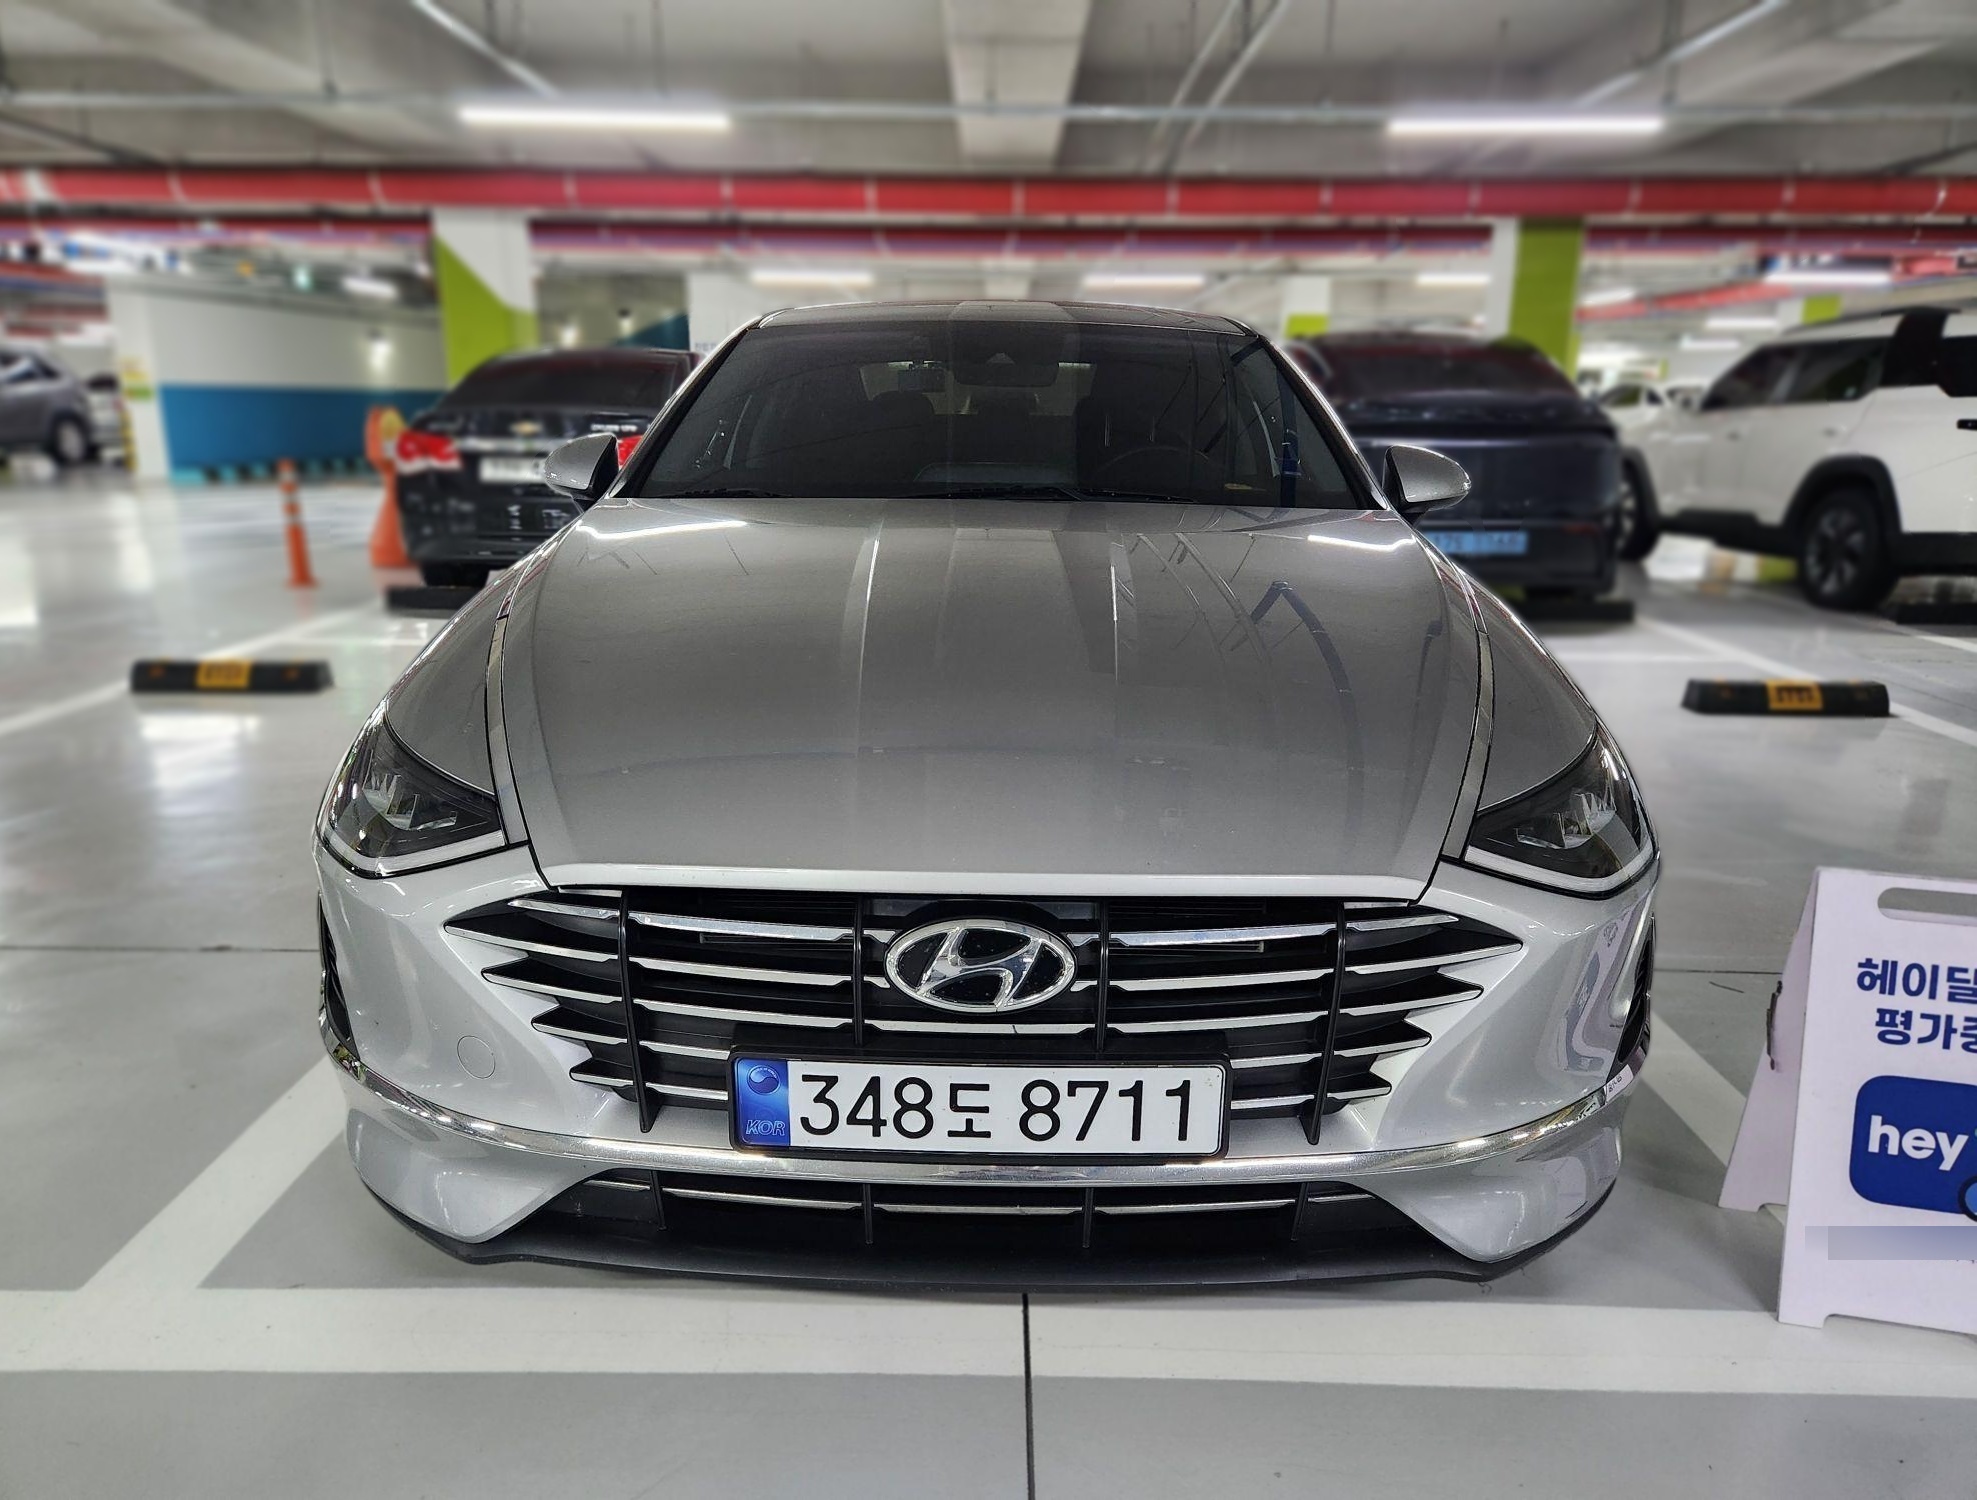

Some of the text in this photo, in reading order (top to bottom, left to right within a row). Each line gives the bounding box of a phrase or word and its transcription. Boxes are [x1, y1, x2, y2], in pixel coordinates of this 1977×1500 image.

[746, 1120, 786, 1136] KOR
[800, 1074, 1191, 1142] 348도 8711
[1867, 1114, 1969, 1171] hey
